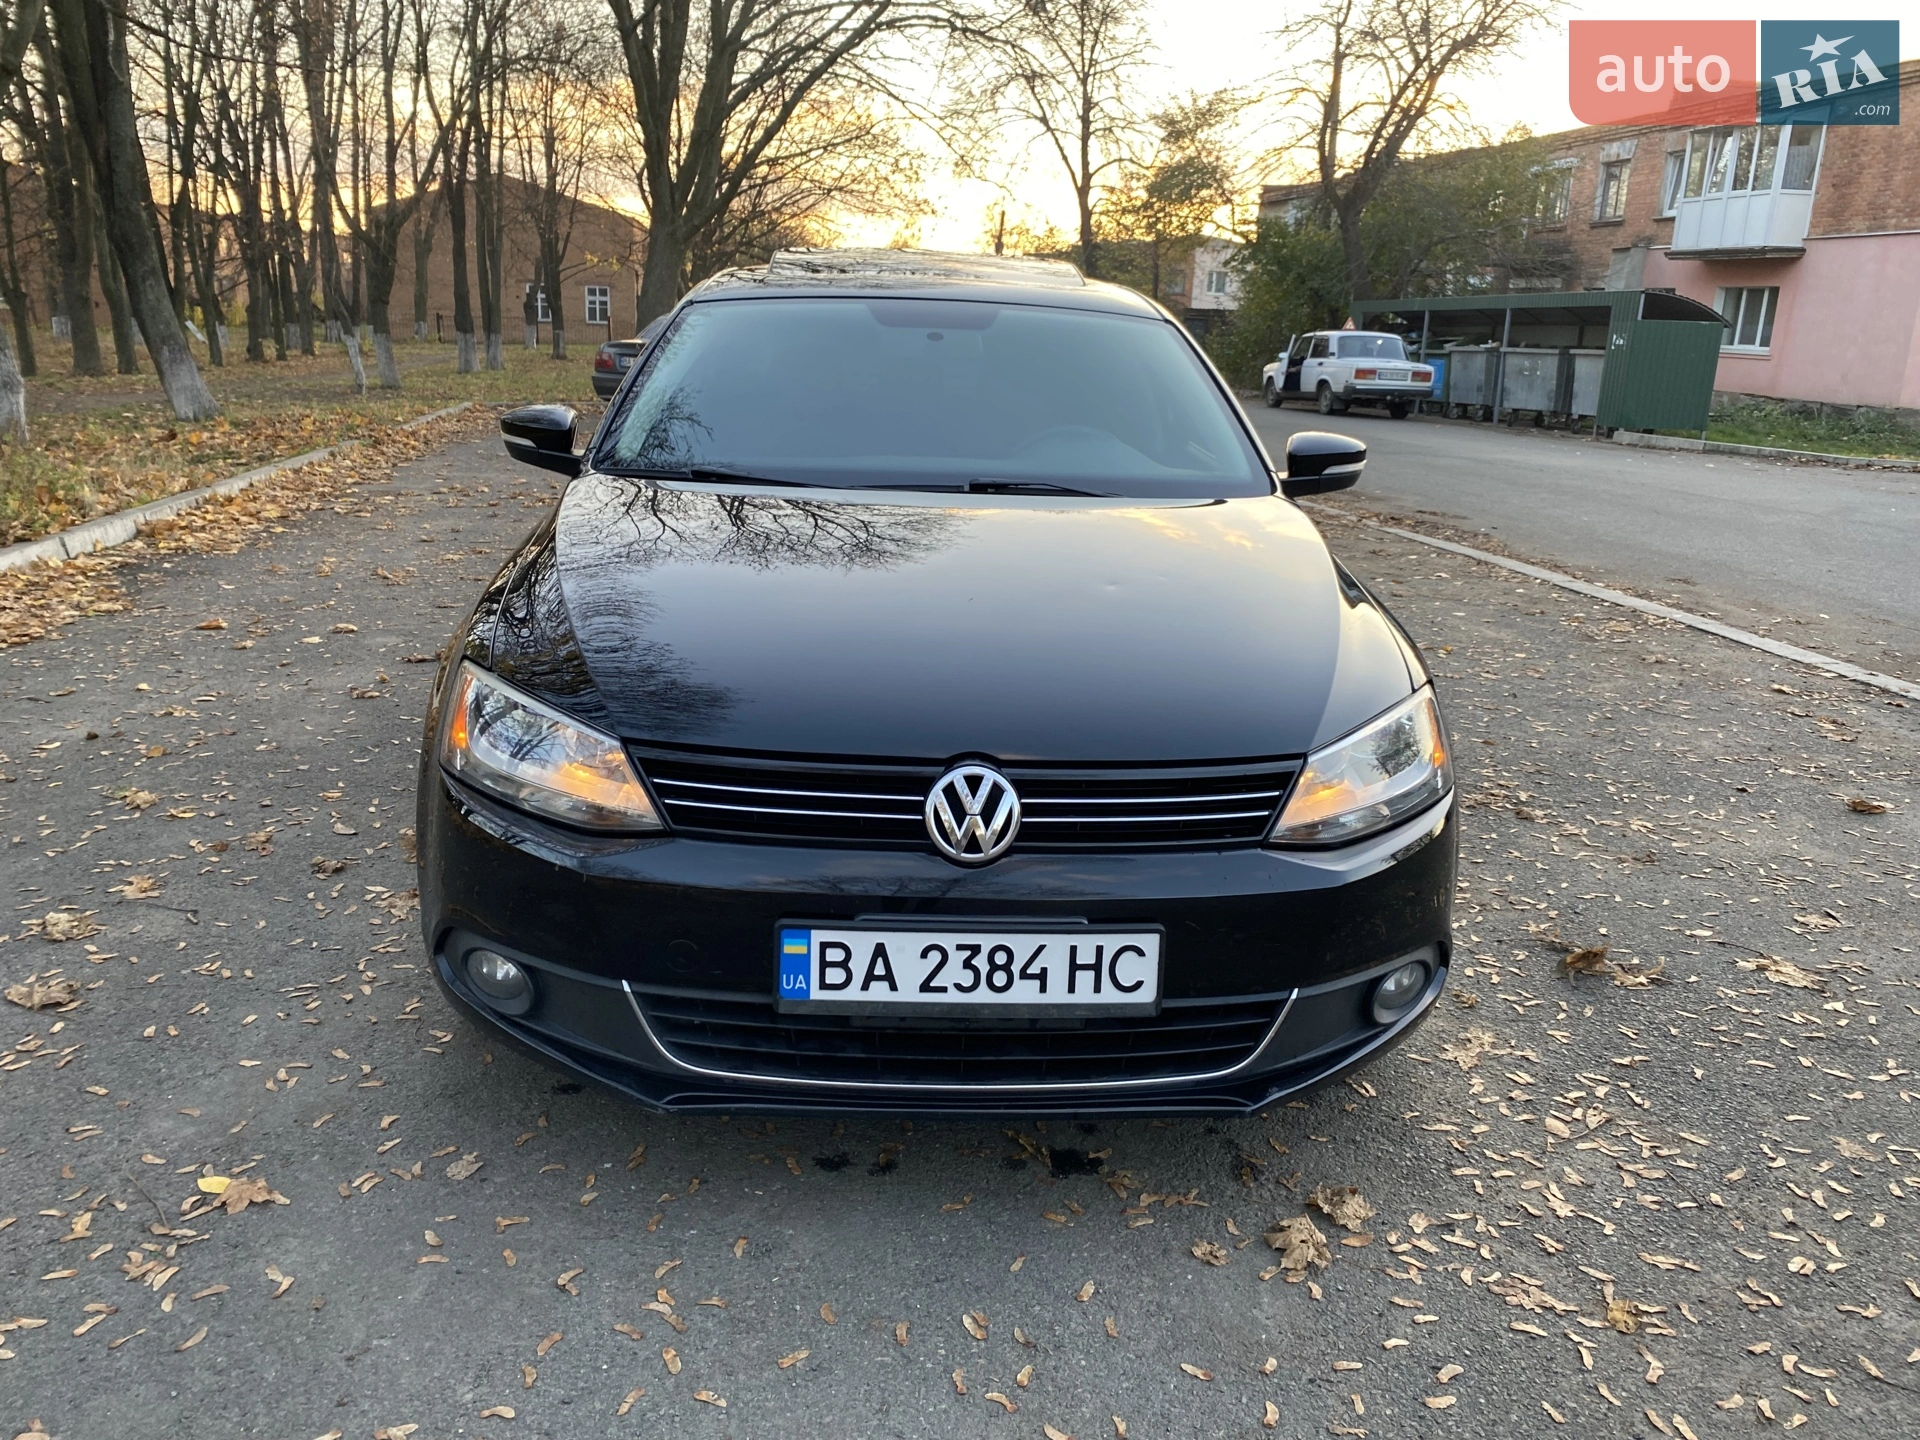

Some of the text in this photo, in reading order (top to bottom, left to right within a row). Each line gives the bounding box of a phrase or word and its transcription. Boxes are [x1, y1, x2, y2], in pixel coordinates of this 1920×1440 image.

[782, 973, 807, 990] UA
[818, 940, 1147, 995] BA 2384 HC
